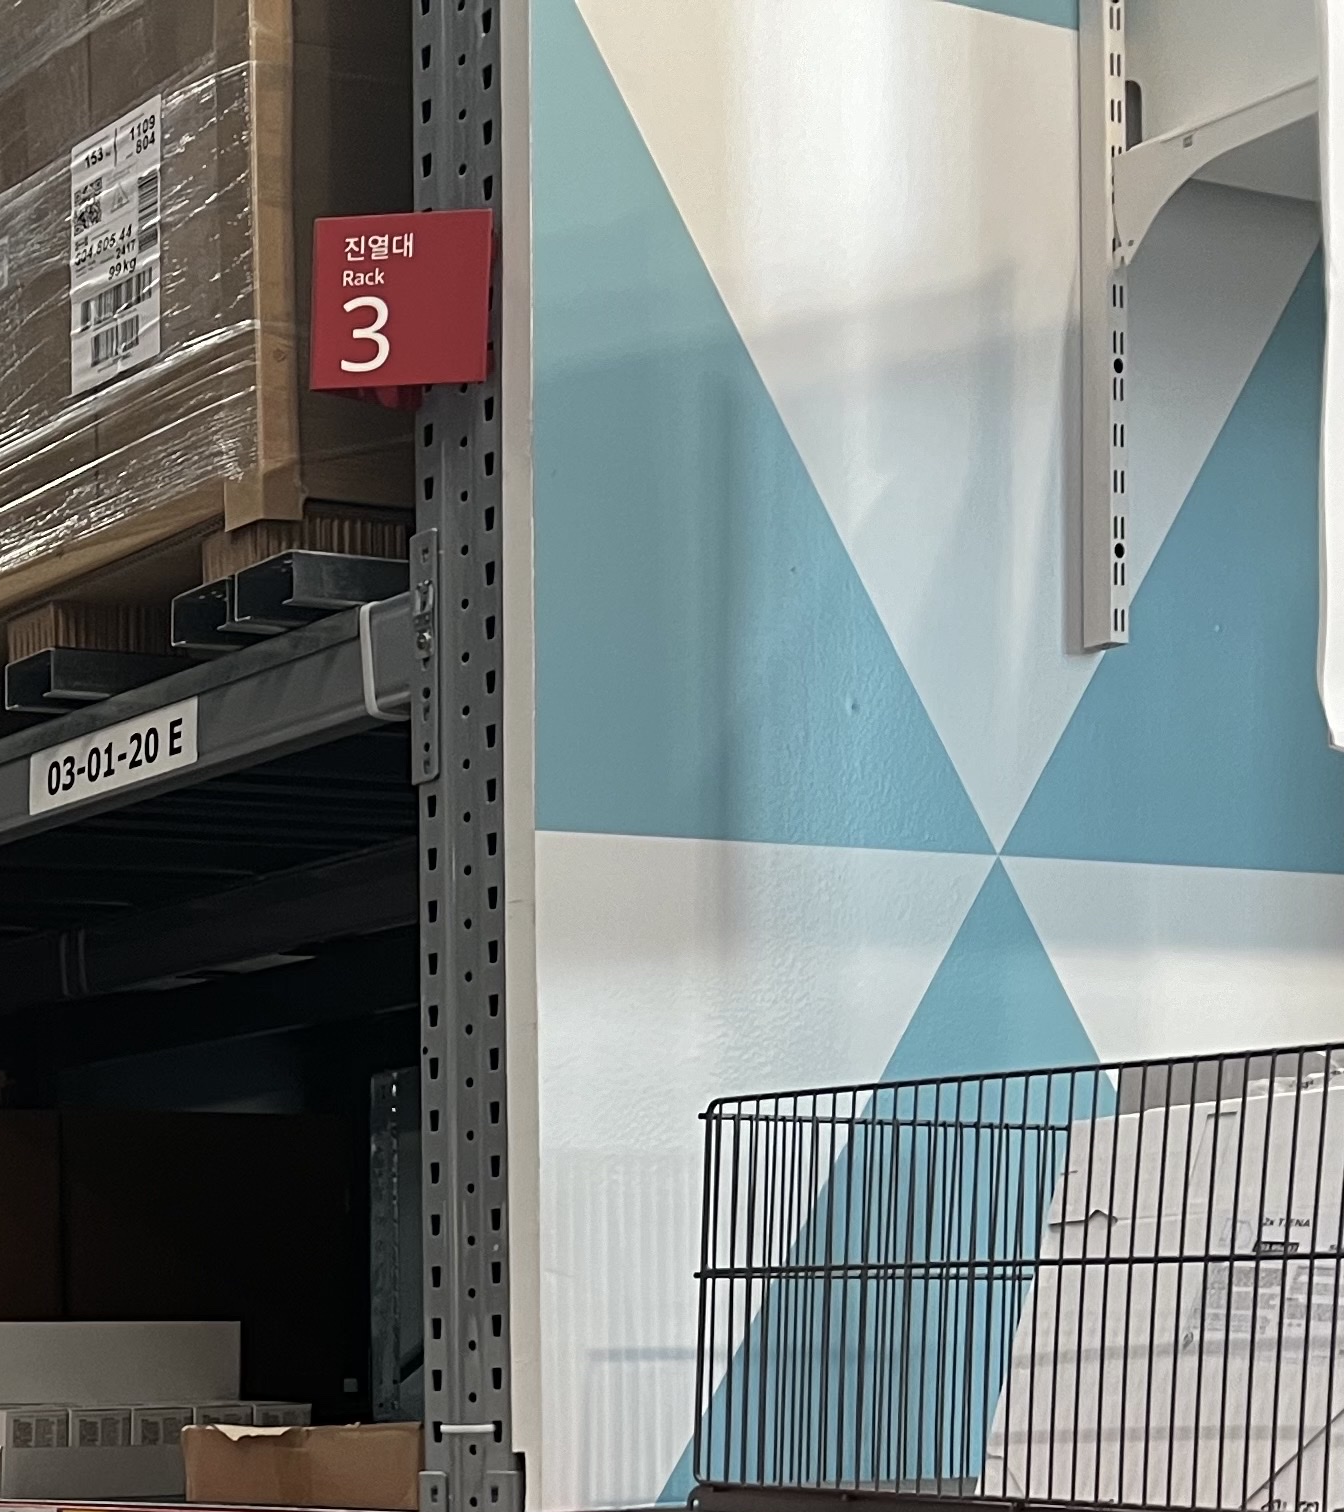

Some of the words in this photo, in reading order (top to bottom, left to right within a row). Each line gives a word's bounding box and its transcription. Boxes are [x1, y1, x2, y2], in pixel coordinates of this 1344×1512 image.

[129, 114, 156, 141] 1109
[136, 131, 156, 155] 804
[343, 232, 414, 262] 진열대
[342, 267, 385, 287] Rack
[340, 295, 391, 373] 3
[47, 727, 159, 796] 03-01-20
[169, 717, 183, 757] E
